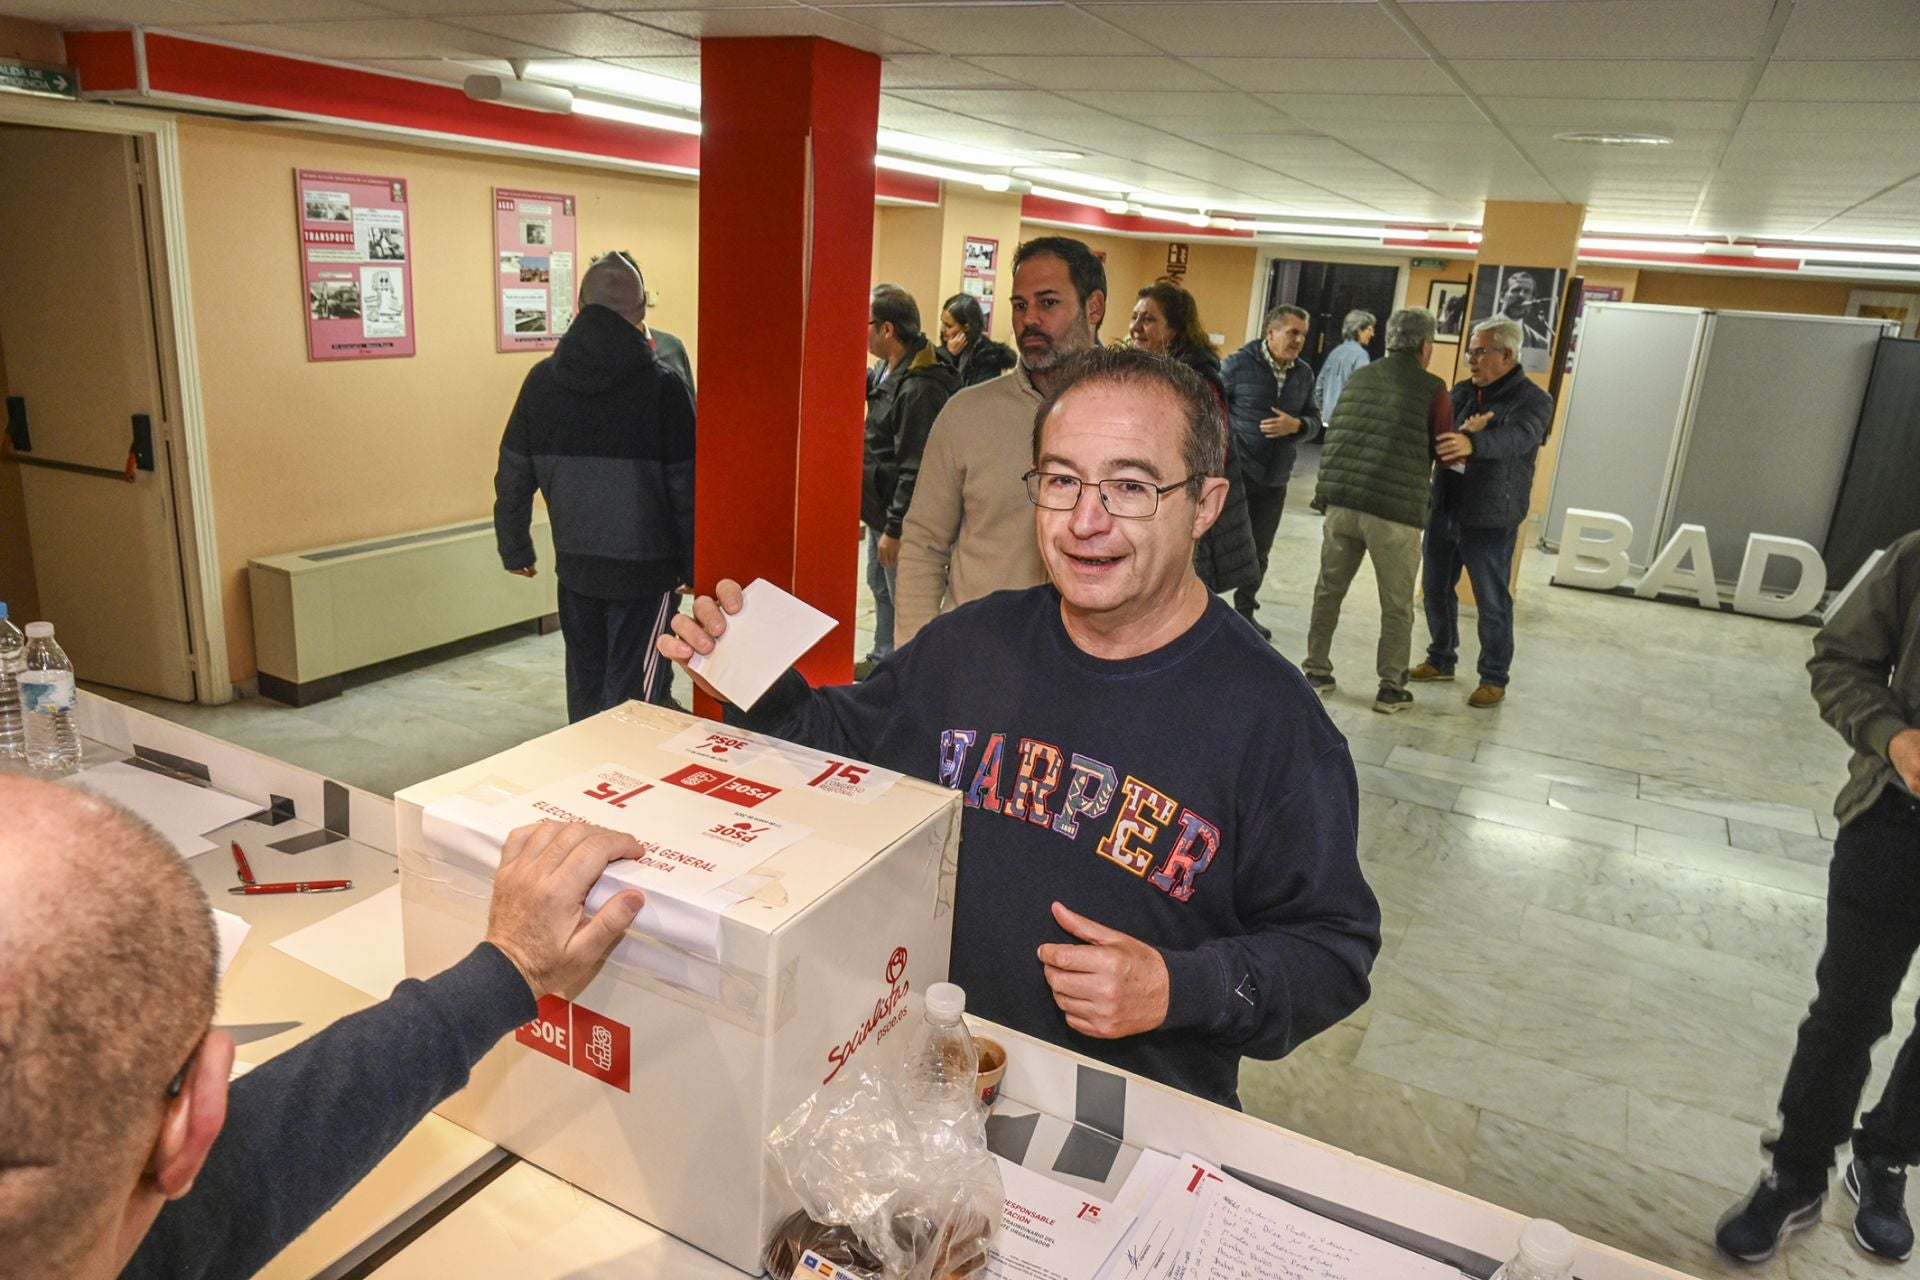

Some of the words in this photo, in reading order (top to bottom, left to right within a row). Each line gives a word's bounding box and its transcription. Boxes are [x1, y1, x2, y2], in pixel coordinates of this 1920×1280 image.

[304, 231, 354, 242] TRANSPORTE
[1556, 507, 1886, 626] BAD
[706, 733, 749, 750] PSOE
[806, 759, 870, 787] 15
[582, 782, 655, 809] 15
[725, 782, 773, 799] PSOE
[938, 728, 1221, 903] HARPER
[708, 824, 758, 843] PSOE
[659, 848, 718, 873] GENERAL
[520, 1019, 566, 1050] SOE
[823, 975, 910, 1085] Socialistas
[877, 1005, 908, 1046] psoe.es
[1186, 1164, 1223, 1193] 1
[1076, 1201, 1101, 1219] 15
[1003, 1217, 1045, 1239] TRAORDINARIO
[1044, 1236, 1055, 1245] DEL
[1010, 1228, 1051, 1249] ORGANIZADOR
